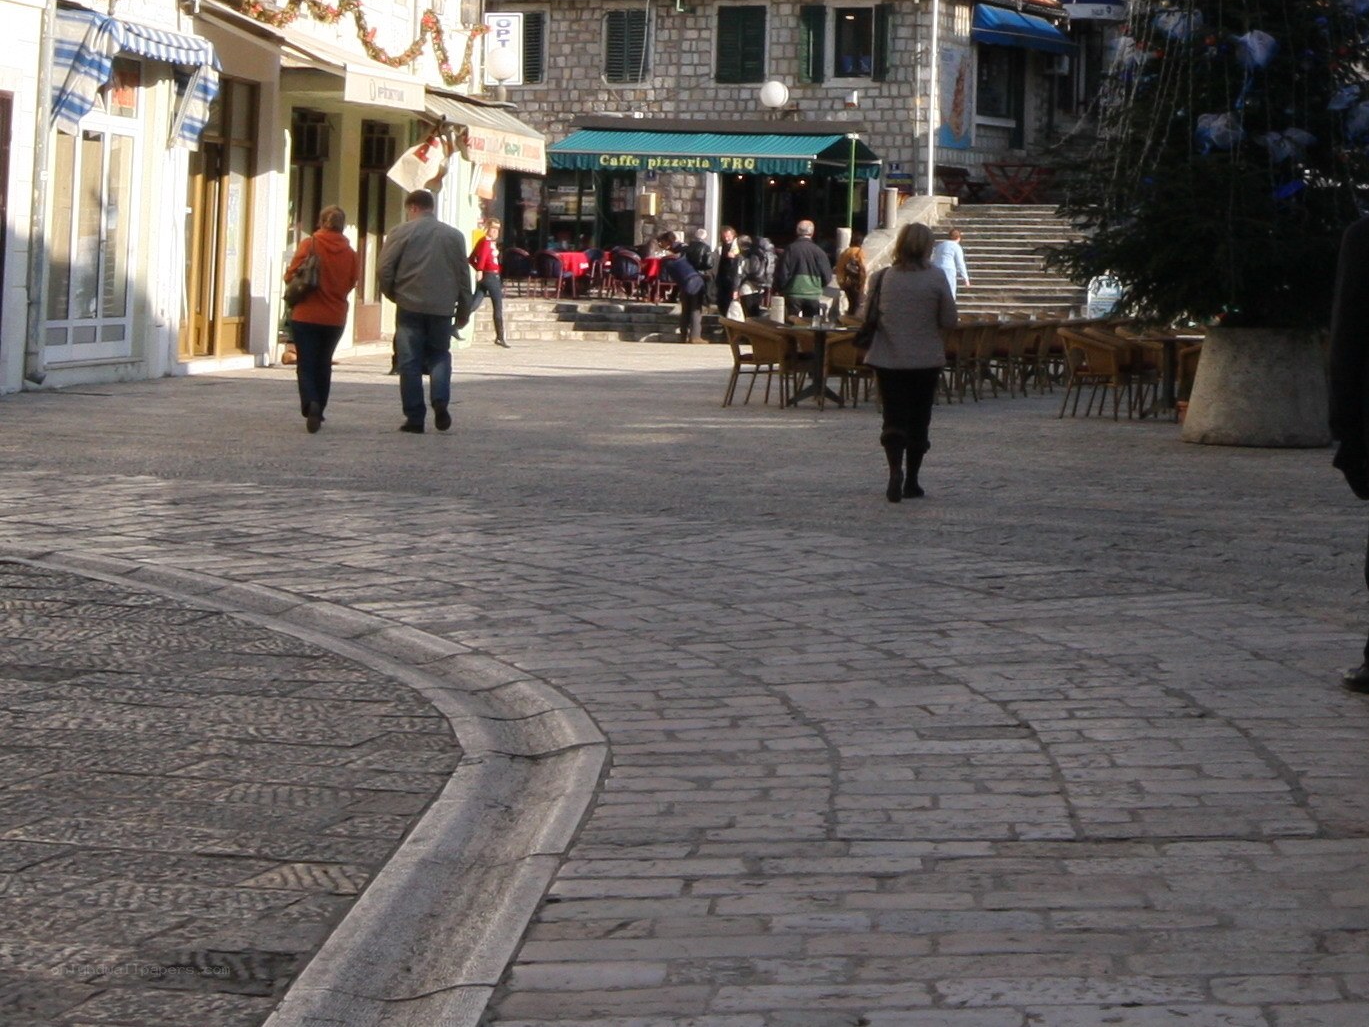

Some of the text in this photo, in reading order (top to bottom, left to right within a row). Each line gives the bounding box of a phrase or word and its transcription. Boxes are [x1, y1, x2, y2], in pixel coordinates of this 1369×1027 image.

[599, 154, 756, 170] Caffe pizzeria TRG
